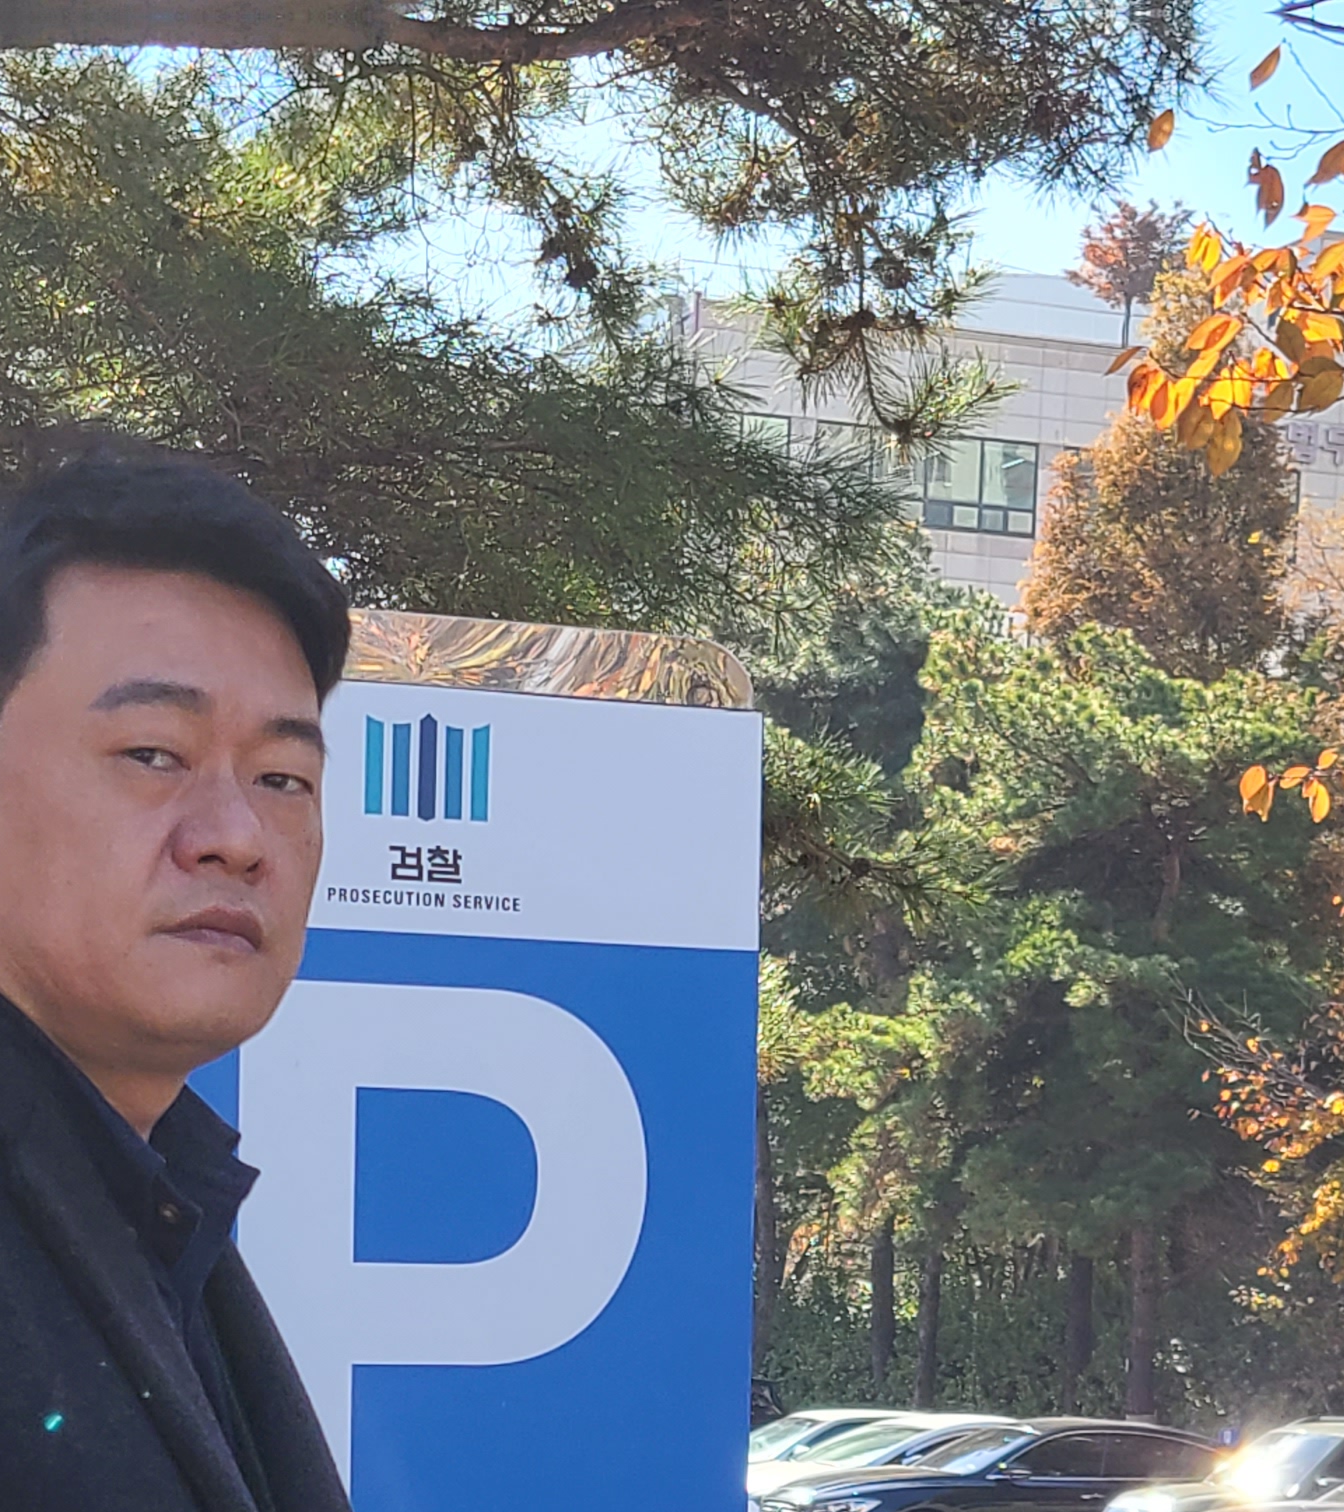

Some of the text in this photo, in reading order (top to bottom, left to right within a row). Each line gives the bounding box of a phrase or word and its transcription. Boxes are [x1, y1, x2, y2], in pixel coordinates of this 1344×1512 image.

[388, 845, 463, 884] 검찰
[327, 887, 522, 912] PROSECUTION SERVICE
[237, 978, 648, 1500] P
